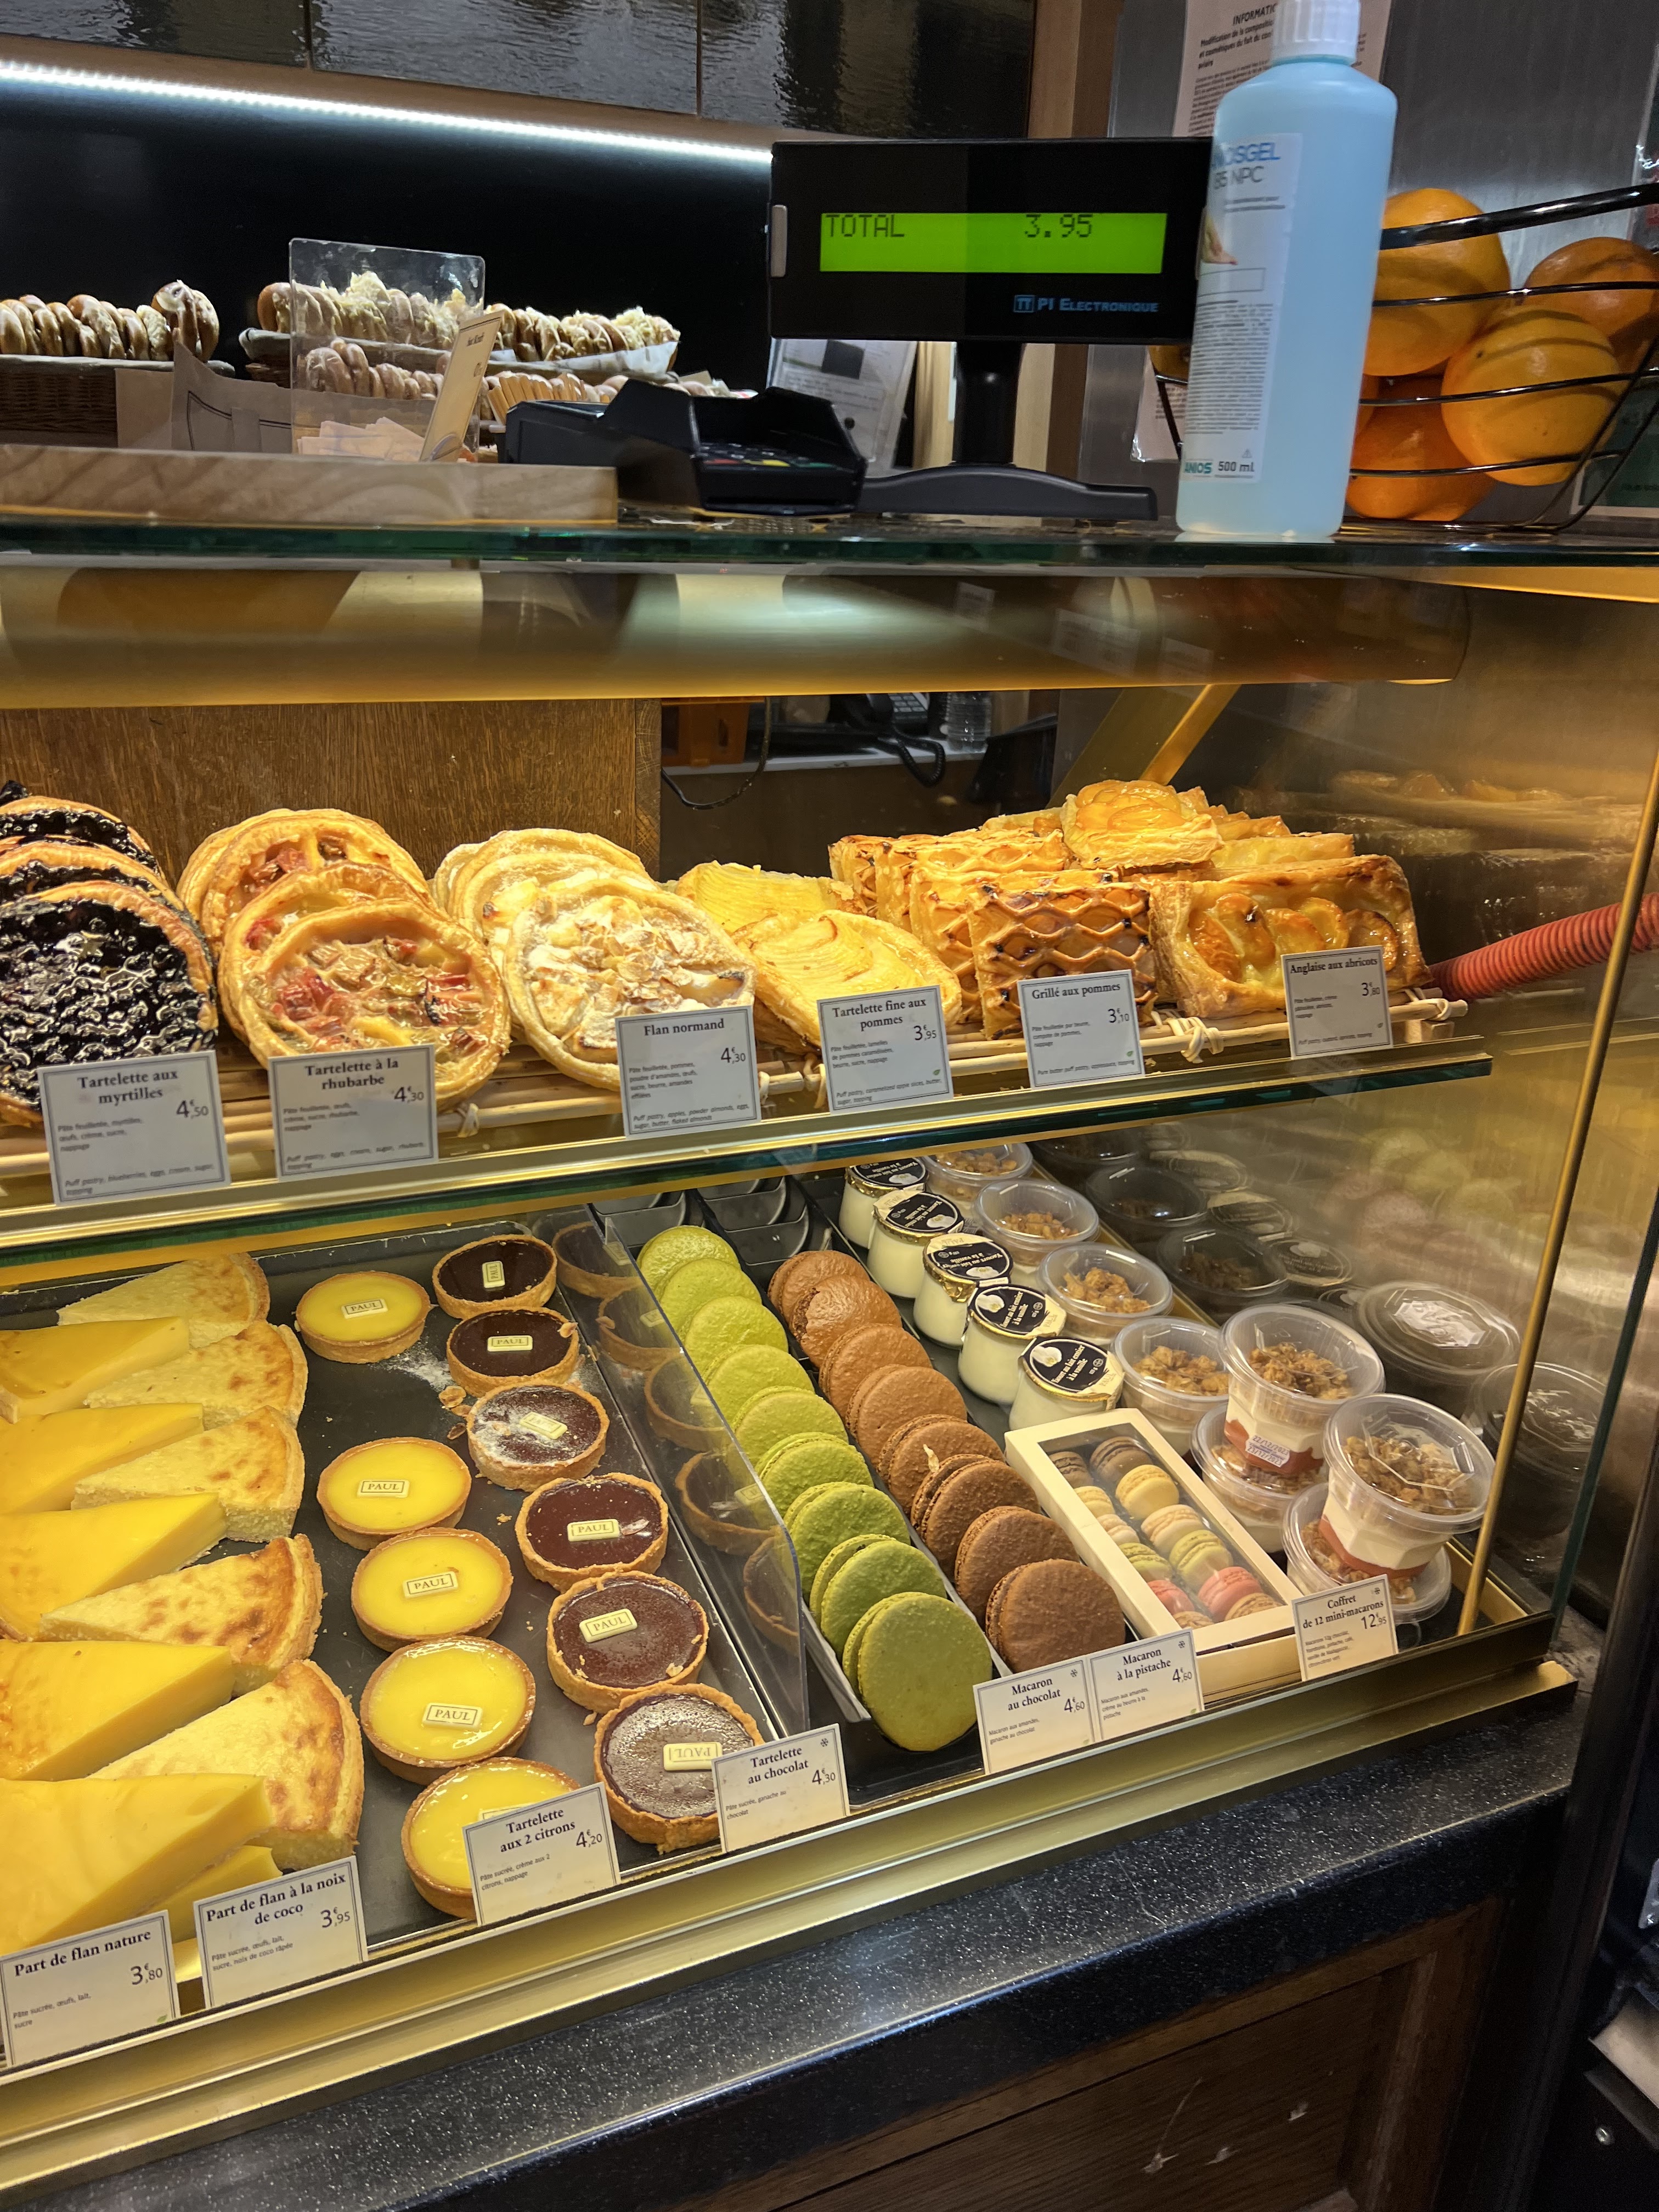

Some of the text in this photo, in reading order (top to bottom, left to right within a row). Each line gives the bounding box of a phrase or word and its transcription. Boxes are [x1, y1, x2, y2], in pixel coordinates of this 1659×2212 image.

[1233, 166, 1264, 184] NPC
[825, 214, 1094, 238] TOTAL 3.95
[1037, 297, 1054, 311] PI
[1218, 461, 1236, 471] 500
[1239, 461, 1254, 472] ml
[1290, 957, 1378, 975] Anglaise aux abricots
[1032, 984, 1120, 999] Grillé aux pommes
[832, 999, 926, 1018] Tartelette fine aux
[644, 1018, 725, 1036] Flan normand
[860, 1016, 903, 1032] pommes
[305, 1058, 399, 1076] Tartelette à la
[77, 1071, 178, 1088] Tartelette aux
[322, 1075, 385, 1090] rhubarbe
[99, 1087, 162, 1106] myrtilles
[489, 1264, 499, 1279] PAUL
[351, 1303, 377, 1311] PAUL
[1064, 1358, 1076, 1367] lait
[1072, 1345, 1086, 1359] entier
[1074, 1358, 1088, 1373] vanille
[1099, 1373, 1115, 1386] PAUL
[1252, 1435, 1289, 1455] 22/12/2023
[578, 1523, 610, 1533] PAUL
[414, 1578, 449, 1589] PAUL
[1327, 1595, 1357, 1609] Coffret
[1303, 1600, 1384, 1629] de 12 mini-macarons
[593, 1617, 627, 1631] PAUL
[1122, 1649, 1162, 1666] Macaron
[1117, 1659, 1171, 1680] à la pistache
[1012, 1678, 1053, 1695] Macaron
[1008, 1689, 1060, 1711] au chocolat
[435, 1709, 471, 1720] PAUL
[674, 1747, 711, 1758] PAUL
[751, 1746, 803, 1768] Tartelette
[748, 1759, 809, 1784] au chocolat
[506, 1810, 564, 1833] Tartelette
[727, 1809, 748, 1820] chocolat
[500, 1821, 575, 1853] aux 2 citrons
[480, 1874, 493, 1882] Pâte
[494, 1866, 515, 1877] sucrée,
[516, 1860, 533, 1870] crème
[504, 1871, 528, 1883] nappage
[206, 1873, 346, 1922] Part de flan à la noix
[255, 1904, 303, 1925] de coco
[14, 1931, 151, 1976] Part de flan nature
[212, 1953, 226, 1961] Pâte
[228, 1946, 250, 1957] sucrée,
[272, 1936, 284, 1944] lait,
[213, 1962, 232, 1971] sucre,
[233, 1957, 247, 1966] noix
[259, 1949, 274, 1958] coco
[275, 1942, 294, 1954] râpée
[13, 2011, 29, 2019] Pâte
[30, 2004, 55, 2015] sucrée,
[78, 1993, 91, 2001] lait,
[14, 2019, 32, 2029] sucre
